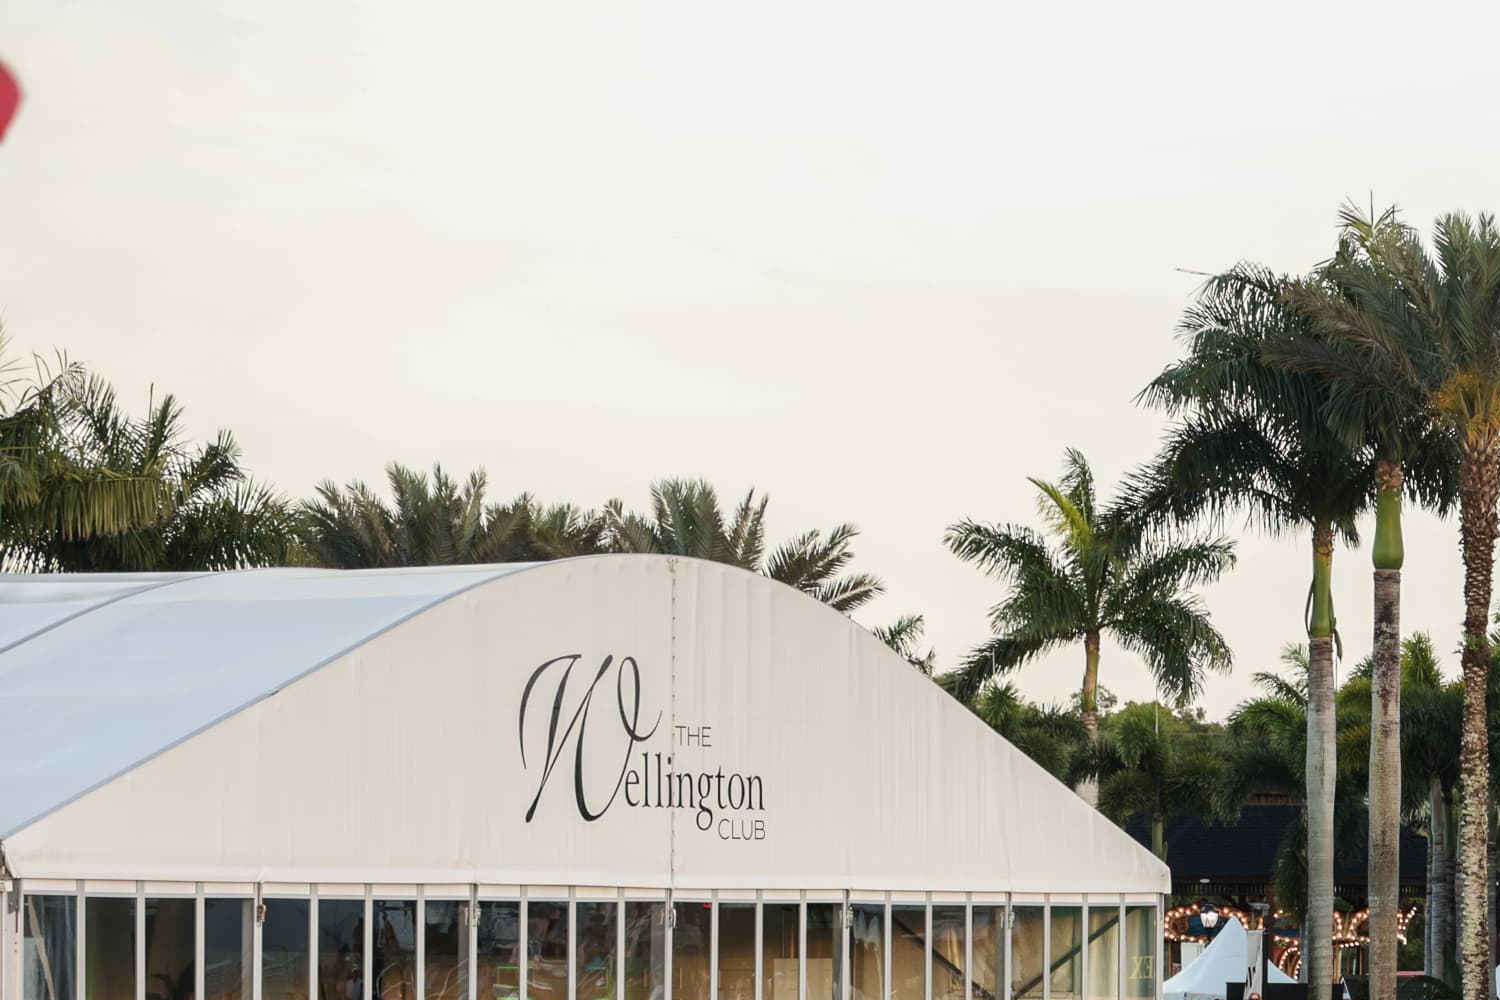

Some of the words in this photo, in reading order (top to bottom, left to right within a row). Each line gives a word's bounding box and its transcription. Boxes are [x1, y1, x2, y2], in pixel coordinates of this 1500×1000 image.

[519, 654, 765, 830] Wellington
[675, 726, 712, 746] THE
[718, 819, 766, 840] CLUB
